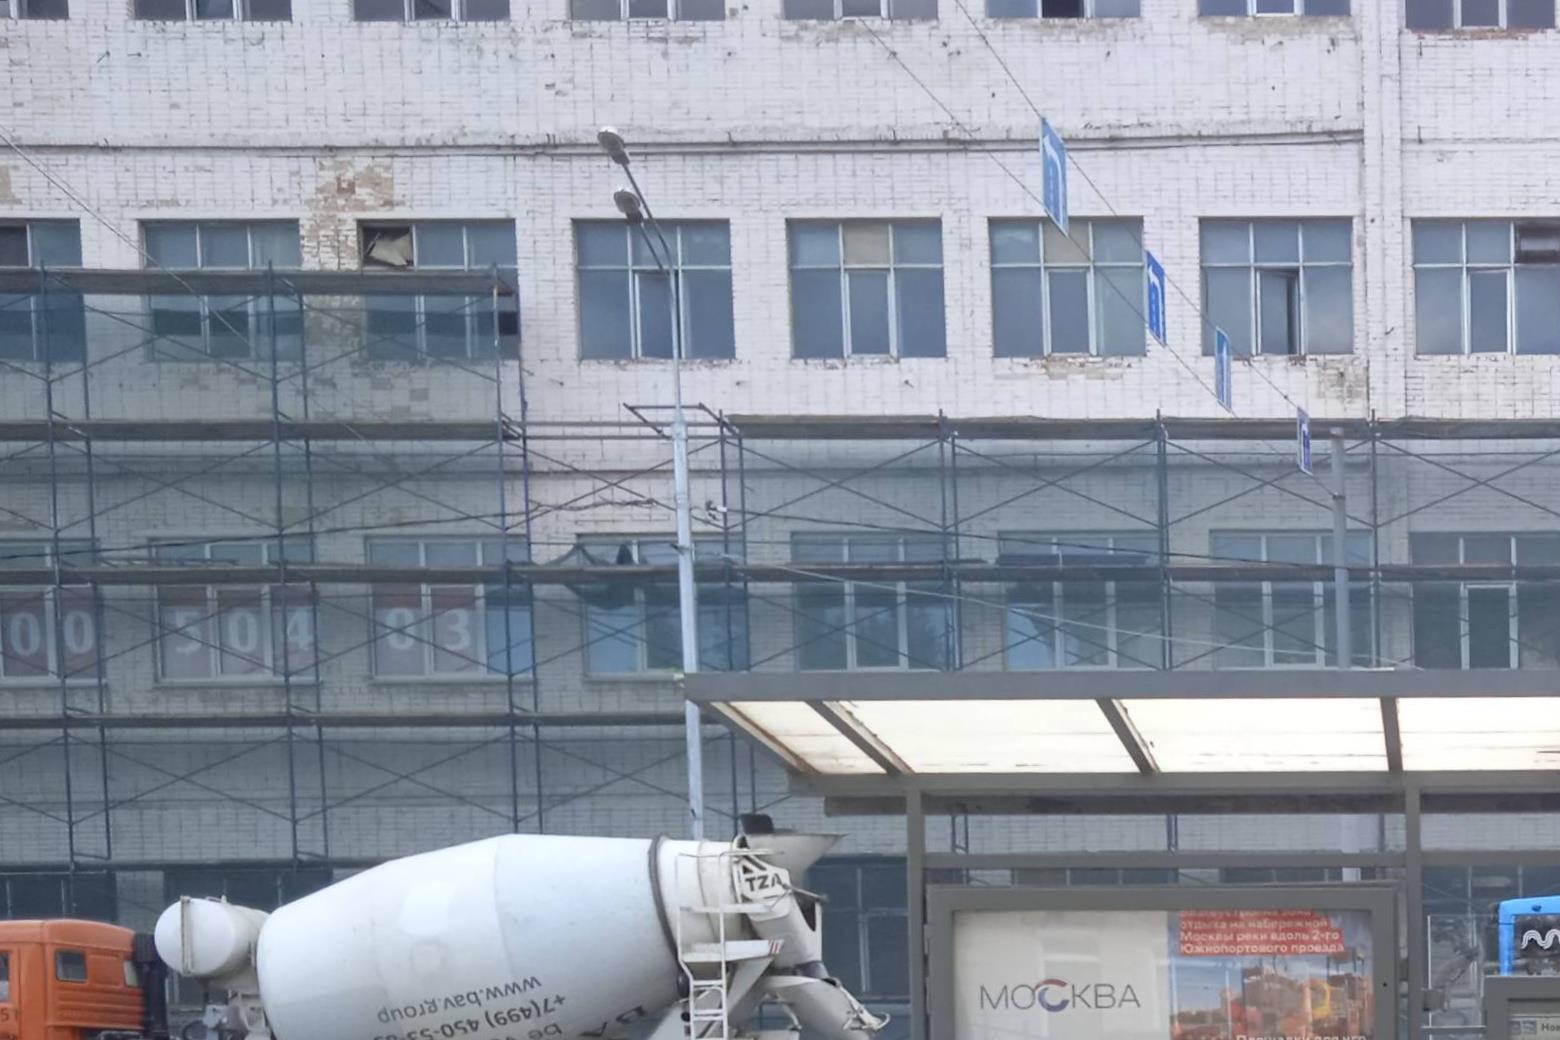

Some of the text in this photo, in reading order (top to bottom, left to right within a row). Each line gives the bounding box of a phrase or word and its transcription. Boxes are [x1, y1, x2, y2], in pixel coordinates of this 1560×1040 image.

[1180, 930, 1340, 943] Москвы реки вдоль 2-го
[1180, 943, 1288, 955] Южнопортового
[377, 975, 542, 1024] www.bav.group
[485, 993, 566, 1029] +7(499)
[979, 978, 1141, 1013] МОСКВА
